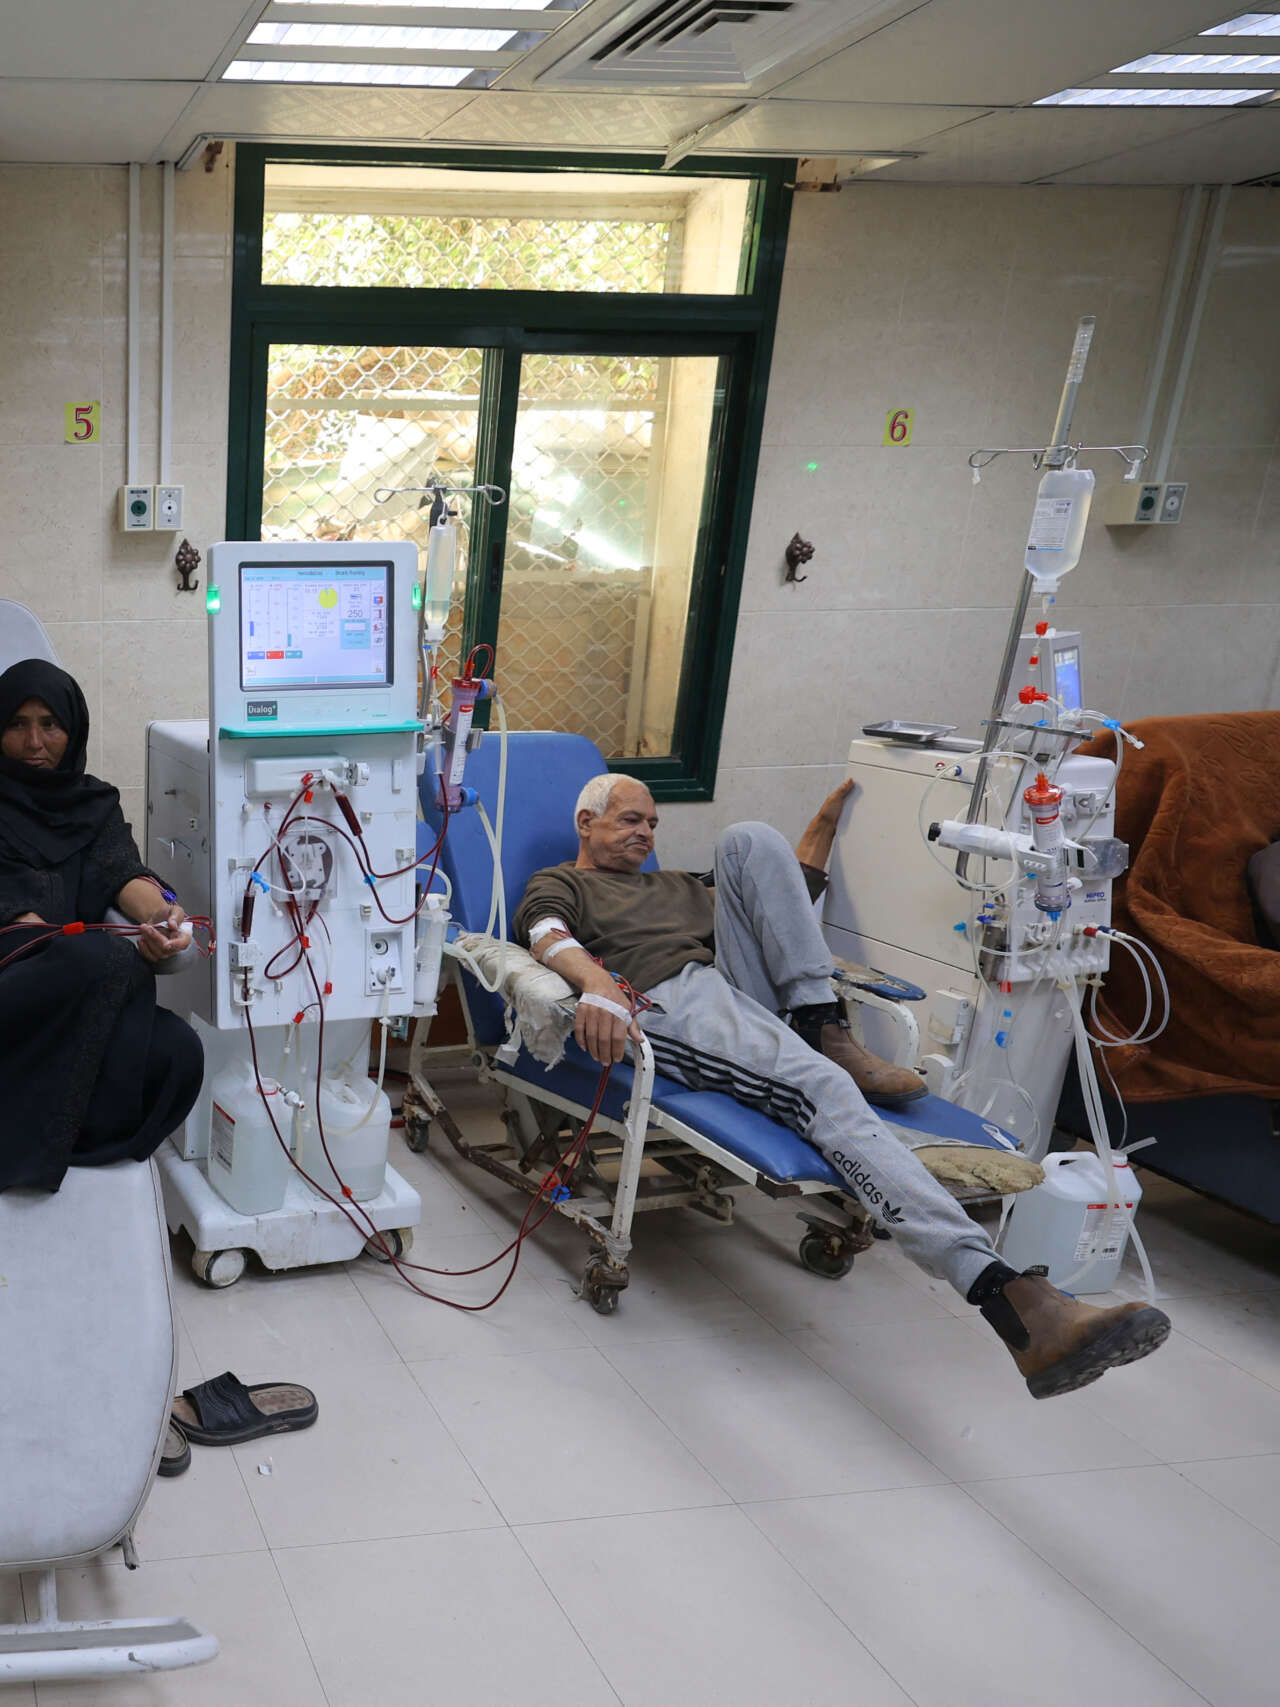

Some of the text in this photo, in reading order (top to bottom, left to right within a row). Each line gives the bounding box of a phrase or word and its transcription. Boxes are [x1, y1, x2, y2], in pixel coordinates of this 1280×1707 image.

[74, 405, 94, 441] 5
[890, 410, 909, 442] 6
[347, 609, 363, 618] 250
[832, 1150, 883, 1204] adidas
